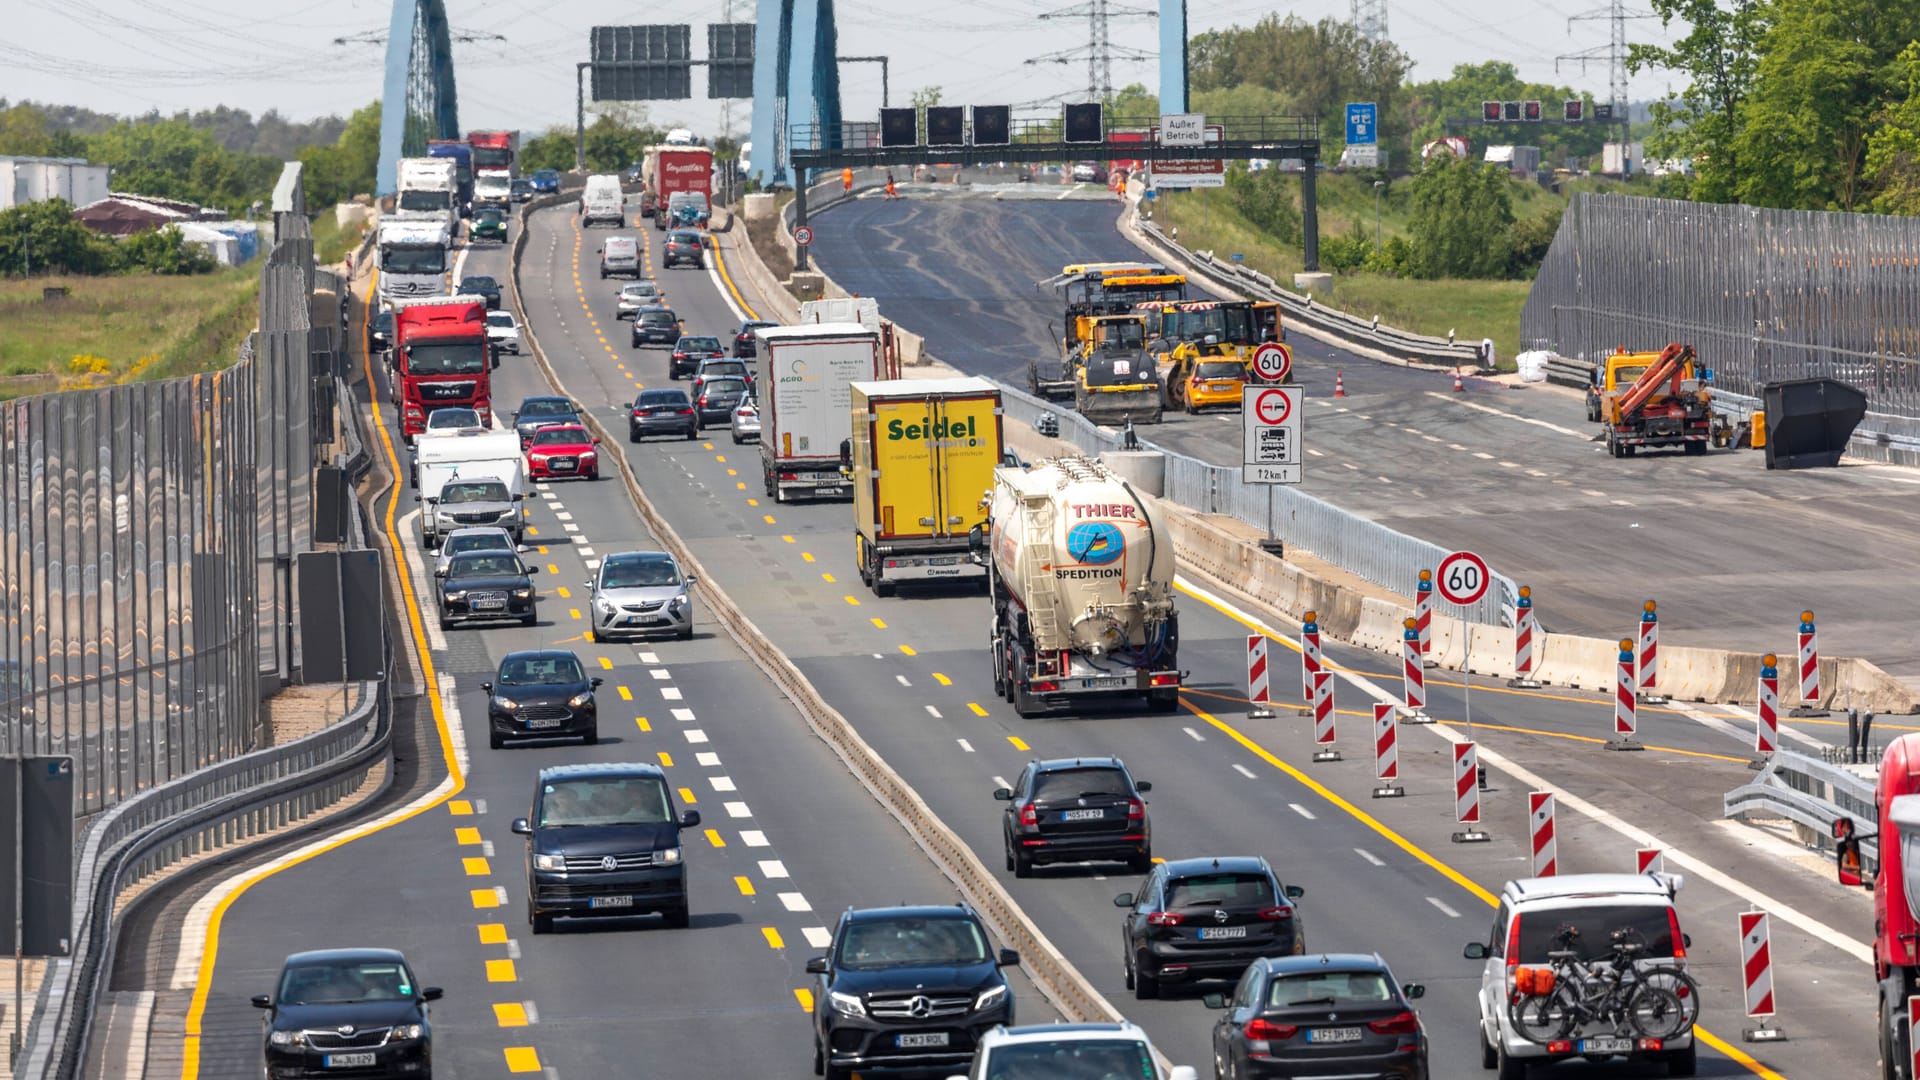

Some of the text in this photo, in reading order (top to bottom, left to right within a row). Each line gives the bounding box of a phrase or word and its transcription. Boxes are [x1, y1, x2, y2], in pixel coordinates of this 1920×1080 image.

[1169, 120, 1196, 129] Außer
[1166, 131, 1200, 140] Betrieb
[798, 231, 808, 240] 80
[1261, 353, 1282, 370] 60
[888, 416, 976, 441] Seidel
[1264, 469, 1282, 479] 2 km
[1072, 503, 1136, 518] THIER
[1056, 568, 1122, 580] SPEDITION
[1448, 566, 1478, 590] 60
